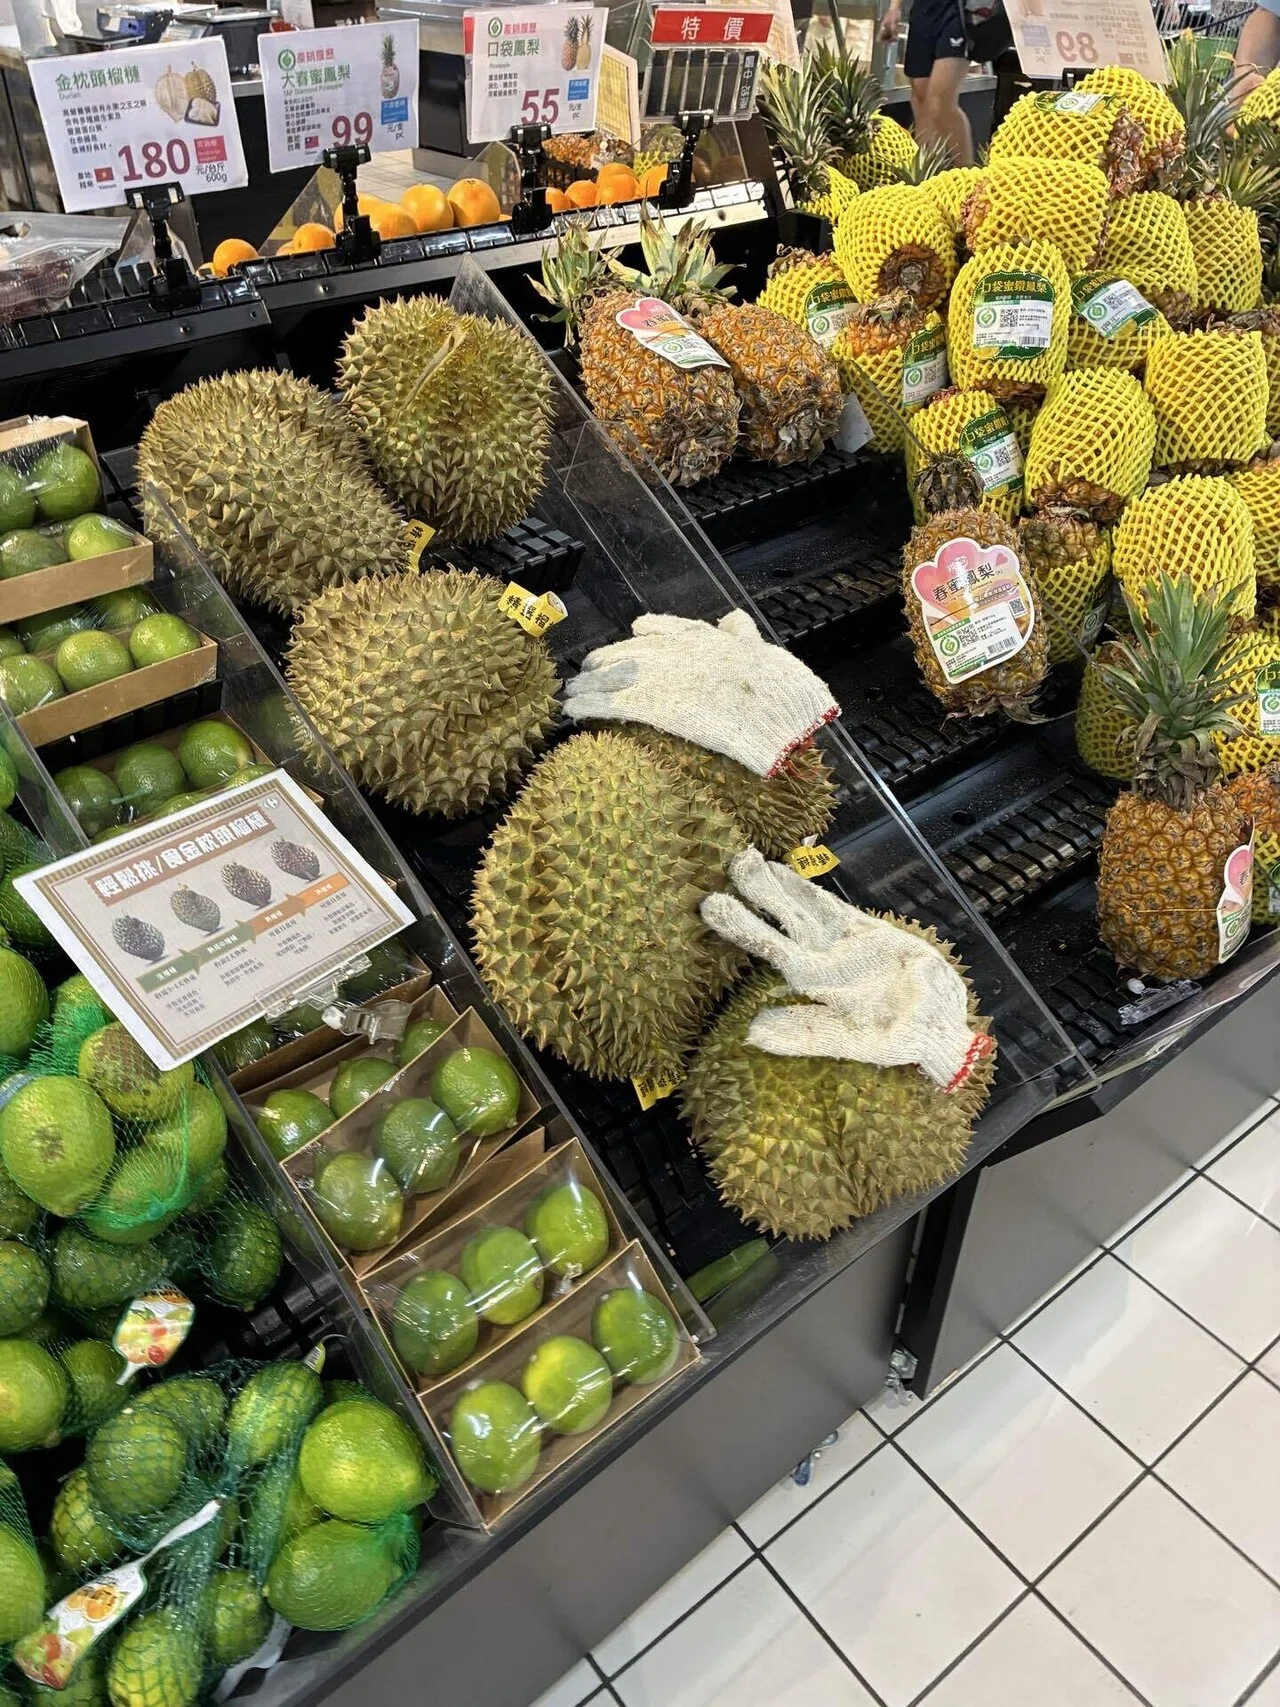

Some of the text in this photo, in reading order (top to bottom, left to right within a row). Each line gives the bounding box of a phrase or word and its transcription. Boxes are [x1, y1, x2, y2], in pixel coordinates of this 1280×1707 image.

[681, 16, 744, 41] 特價
[487, 38, 540, 58] 口袋鳳梨
[521, 88, 560, 125] 55
[332, 112, 373, 148] 99
[118, 138, 191, 182] 180
[206, 172, 228, 183] 600g
